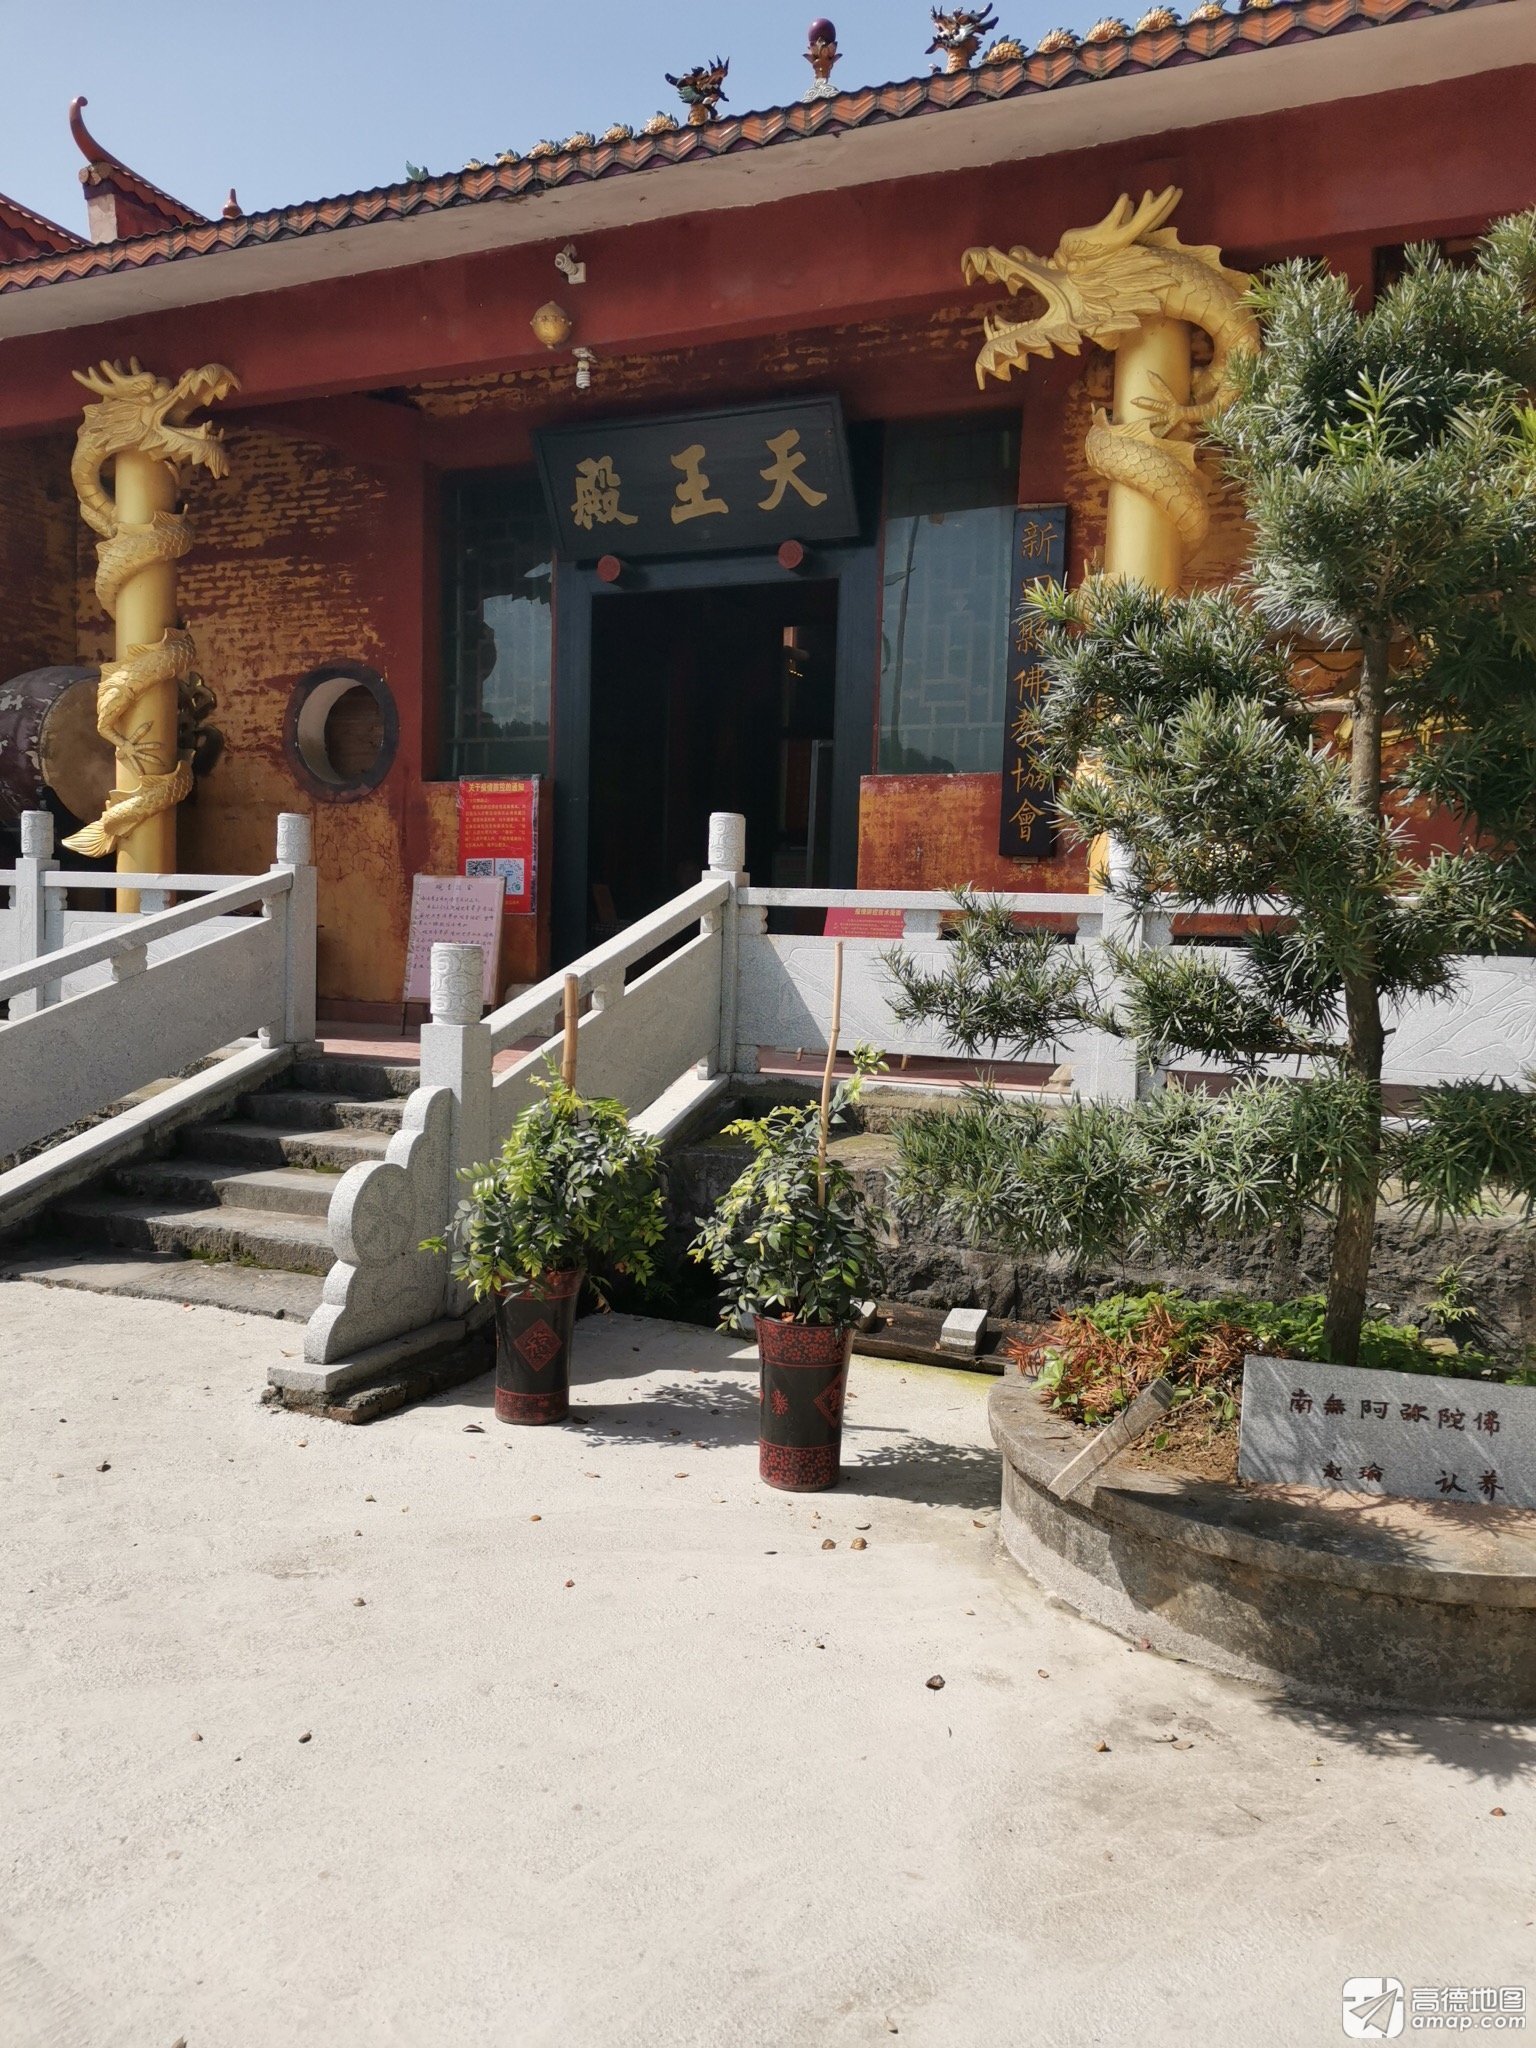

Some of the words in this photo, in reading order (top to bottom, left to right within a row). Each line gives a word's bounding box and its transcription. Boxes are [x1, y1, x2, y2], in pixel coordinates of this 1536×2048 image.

[571, 429, 828, 529] 天王殿
[1290, 1388, 1501, 1437] 南無阿弥陀佛
[1434, 1469, 1504, 1501] 认养
